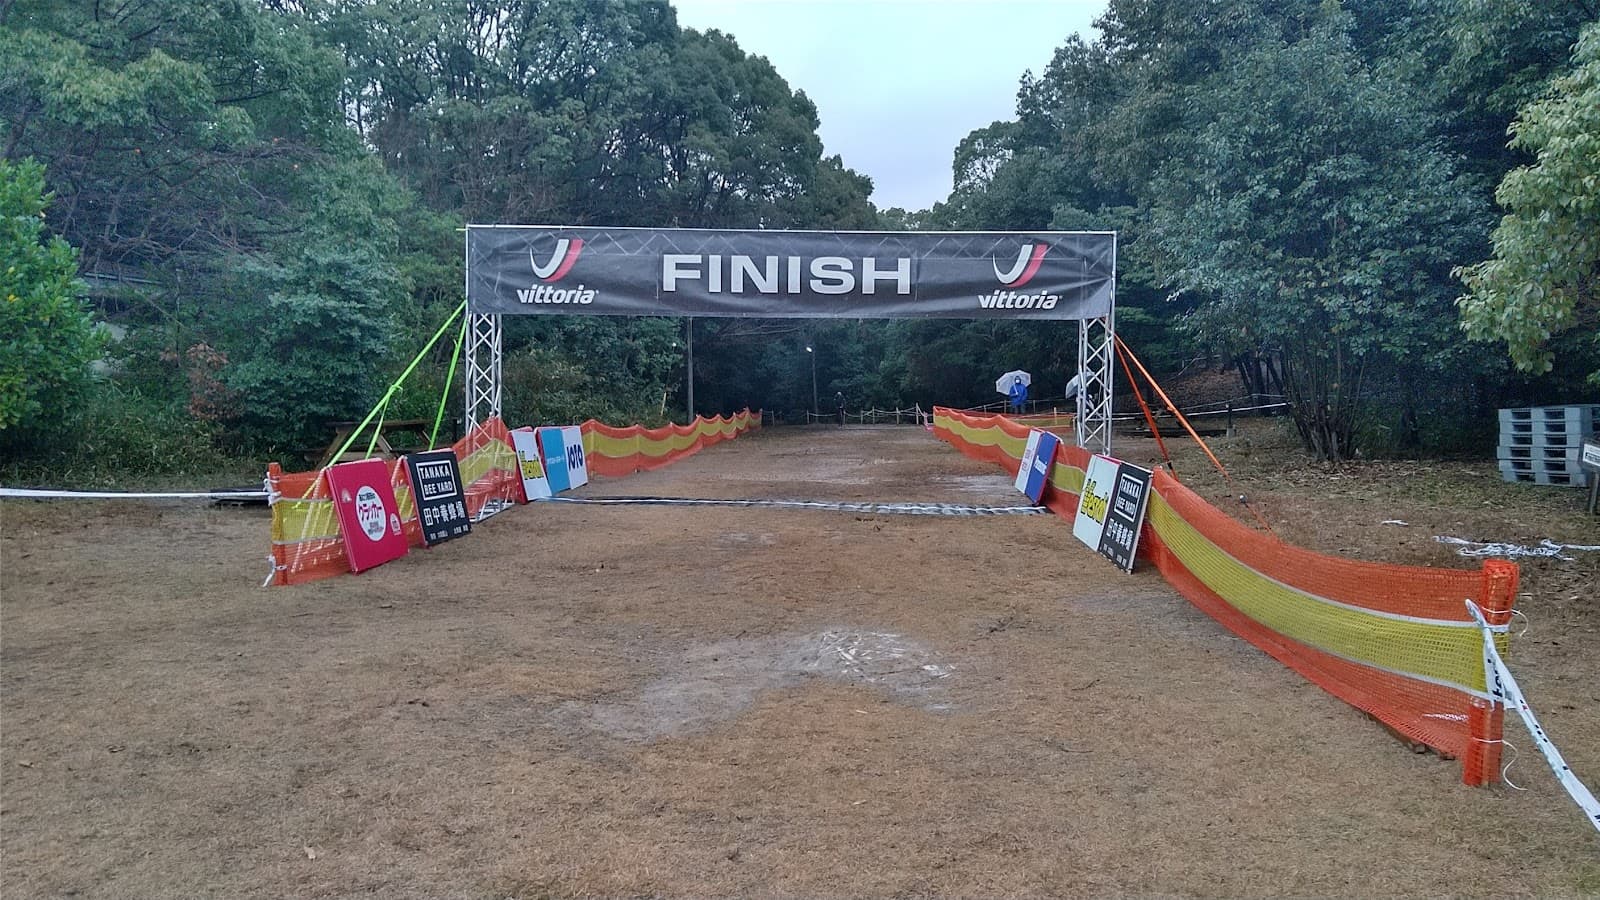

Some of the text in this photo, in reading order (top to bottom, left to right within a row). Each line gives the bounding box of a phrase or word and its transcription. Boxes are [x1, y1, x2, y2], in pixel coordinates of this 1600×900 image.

[663, 254, 910, 294] FINISH
[517, 284, 595, 304] vittoria
[978, 290, 1059, 309] vittoria
[419, 465, 450, 479] TANAKA
[424, 481, 453, 495] BEE YARD
[1120, 478, 1140, 499] TANAKA
